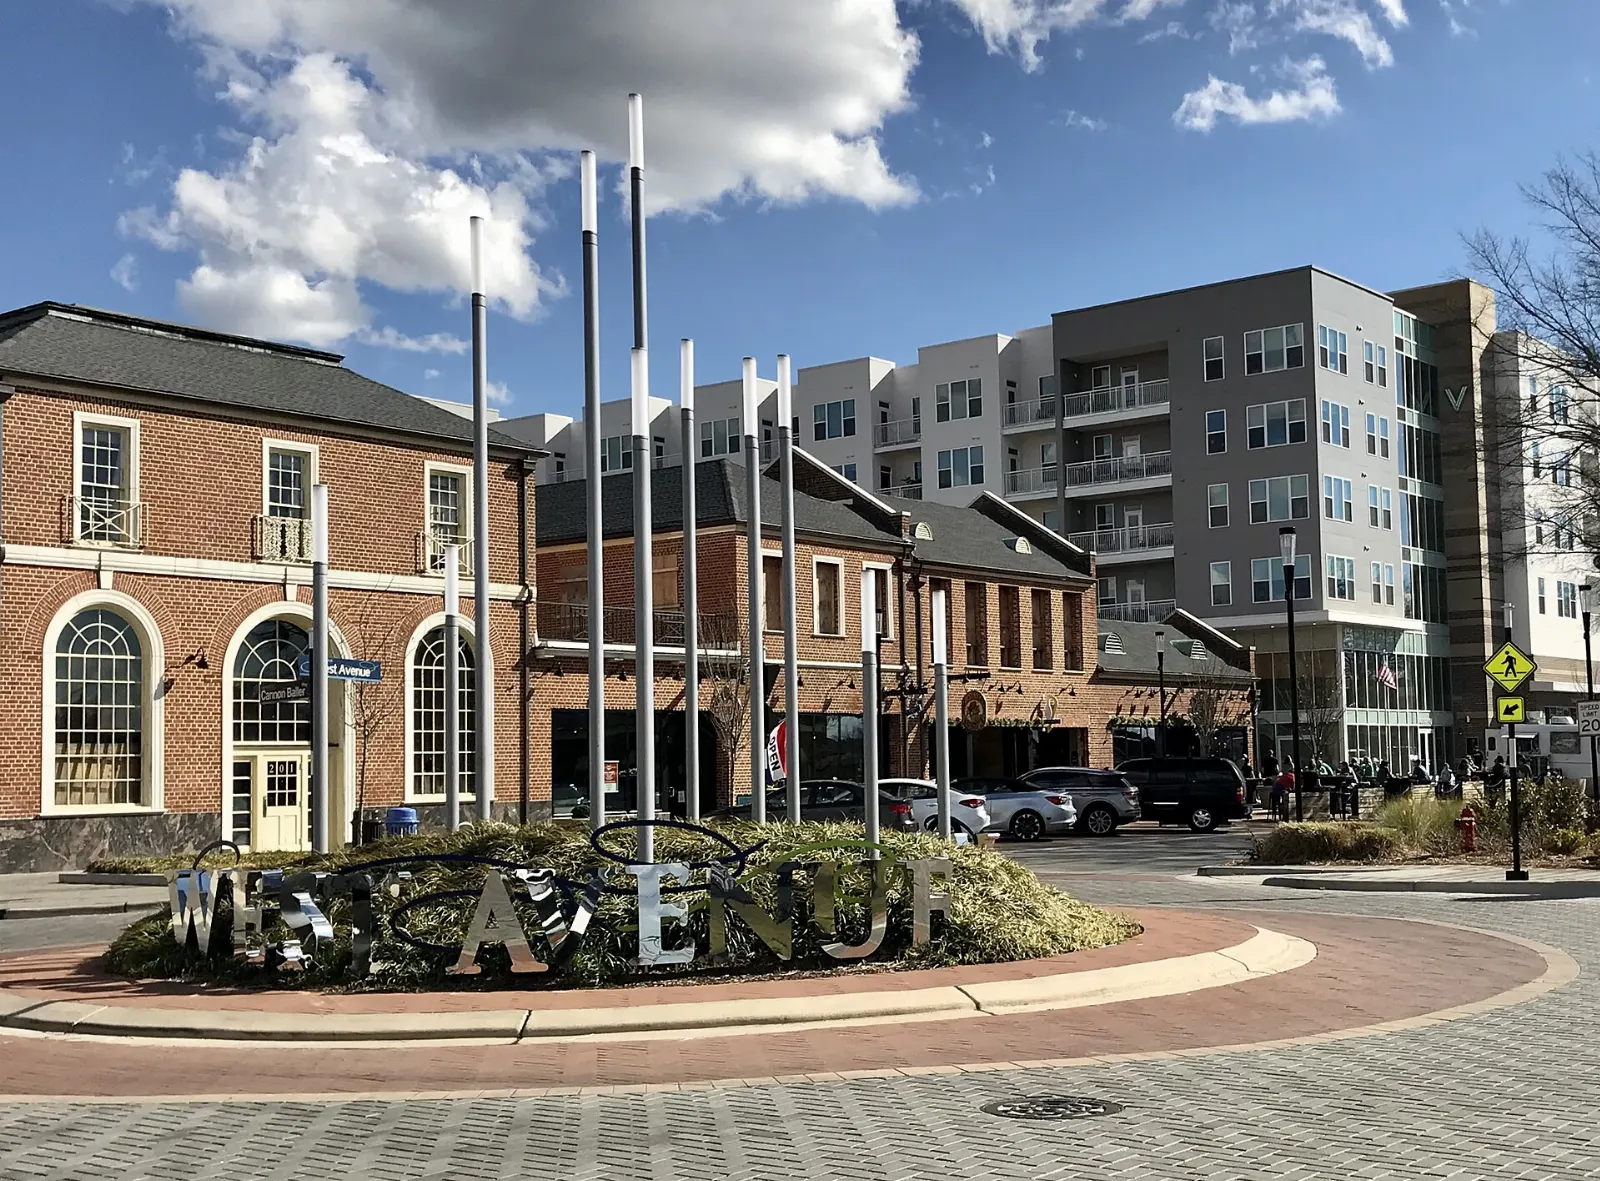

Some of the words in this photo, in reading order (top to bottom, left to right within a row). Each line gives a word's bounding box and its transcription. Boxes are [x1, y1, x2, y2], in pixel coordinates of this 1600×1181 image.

[338, 664, 371, 677] Avenue
[261, 690, 286, 701] Cannon
[1581, 719, 1600, 732] 20
[769, 737, 781, 771] OPEN
[269, 763, 294, 774] 201
[445, 859, 953, 976] AVENUE
